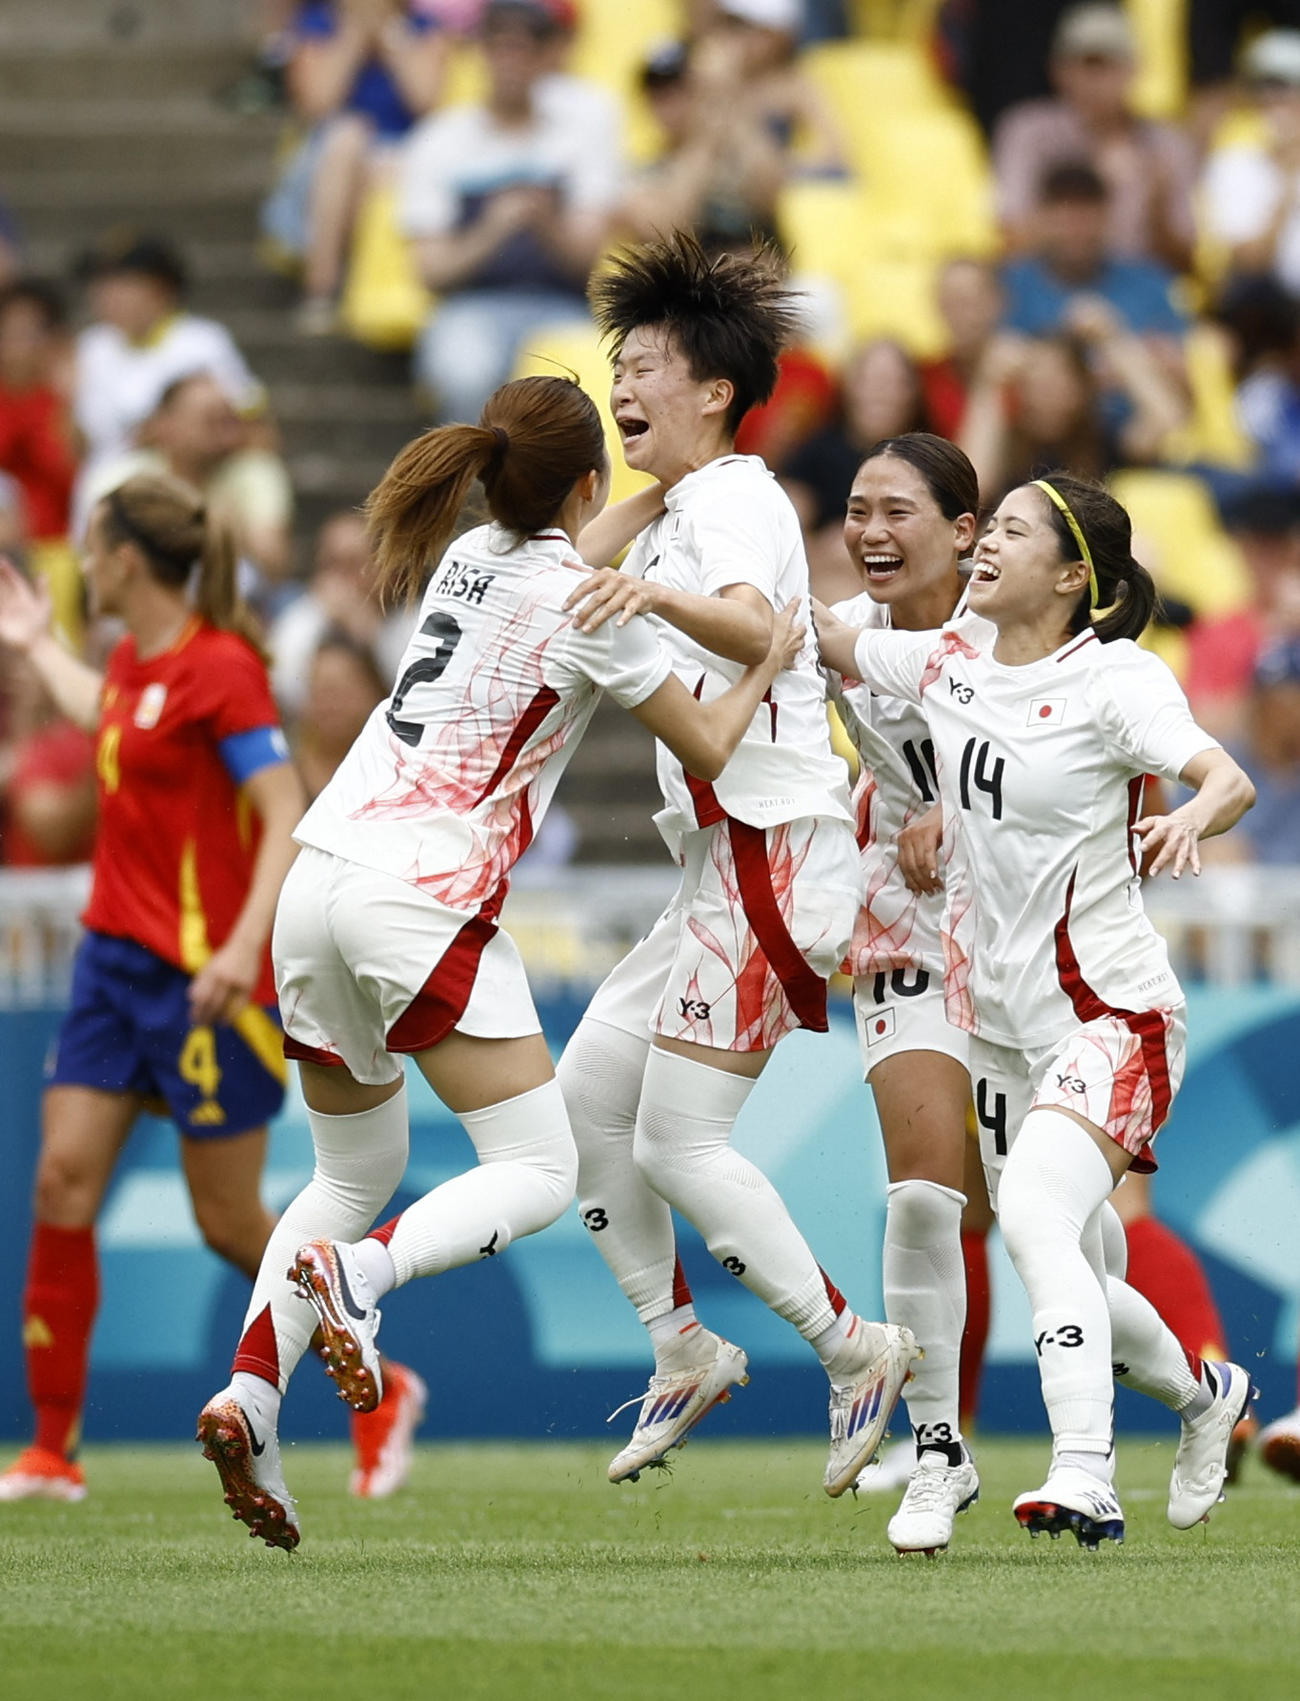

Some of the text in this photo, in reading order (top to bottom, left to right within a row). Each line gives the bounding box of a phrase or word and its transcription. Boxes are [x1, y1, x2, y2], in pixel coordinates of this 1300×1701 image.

[436, 561, 496, 605] RISA
[385, 612, 463, 748] 2
[949, 676, 975, 704] Y-3
[960, 737, 1005, 821] 14
[679, 997, 711, 1020] Y-3
[179, 1023, 222, 1099] 4
[1056, 1074, 1086, 1094] Y-3
[1034, 1325, 1084, 1357] Y-3
[911, 1422, 952, 1445] Y-3
